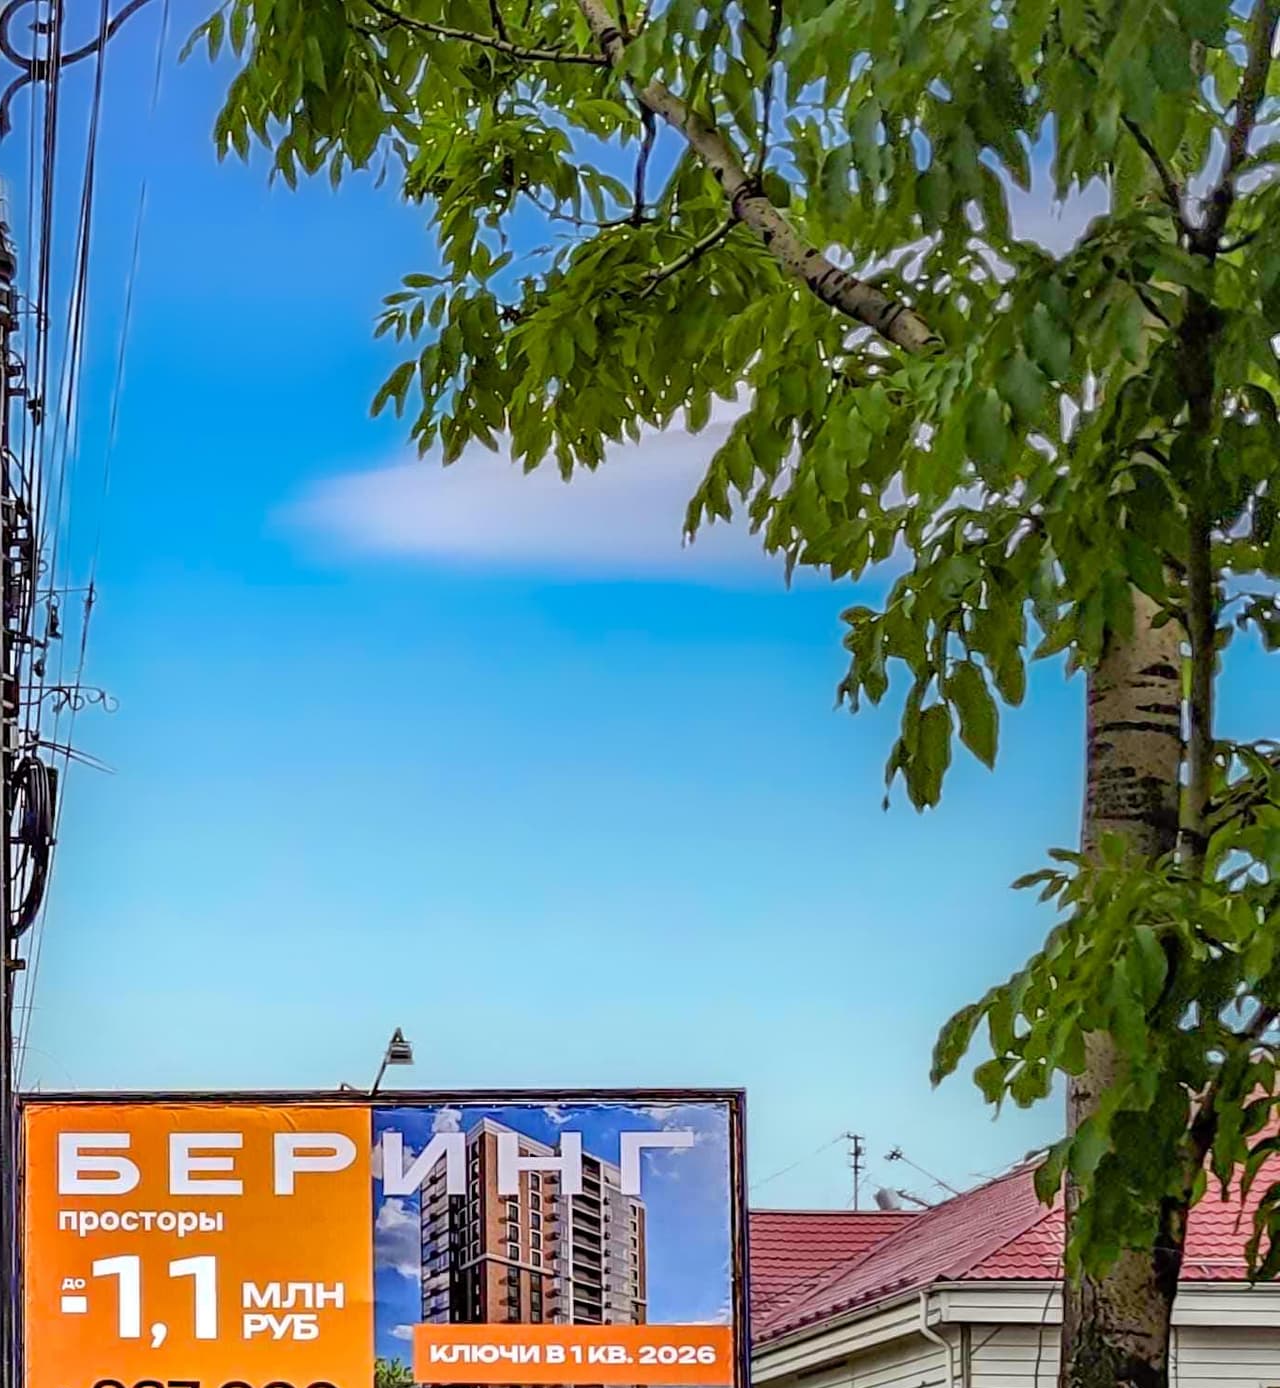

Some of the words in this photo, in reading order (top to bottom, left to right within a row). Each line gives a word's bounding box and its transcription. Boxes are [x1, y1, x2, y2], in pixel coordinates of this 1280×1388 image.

[57, 1131, 695, 1196] БЕРИНГ
[58, 1208, 224, 1238] просторы
[61, 1277, 85, 1290] до
[242, 1281, 345, 1309] МЛН
[242, 1313, 320, 1341] РУБ
[430, 1344, 541, 1364] КЛЮЧИ
[546, 1345, 565, 1363] В
[570, 1345, 584, 1364] 1
[588, 1345, 633, 1364] КВ.
[639, 1345, 716, 1364] 2026
